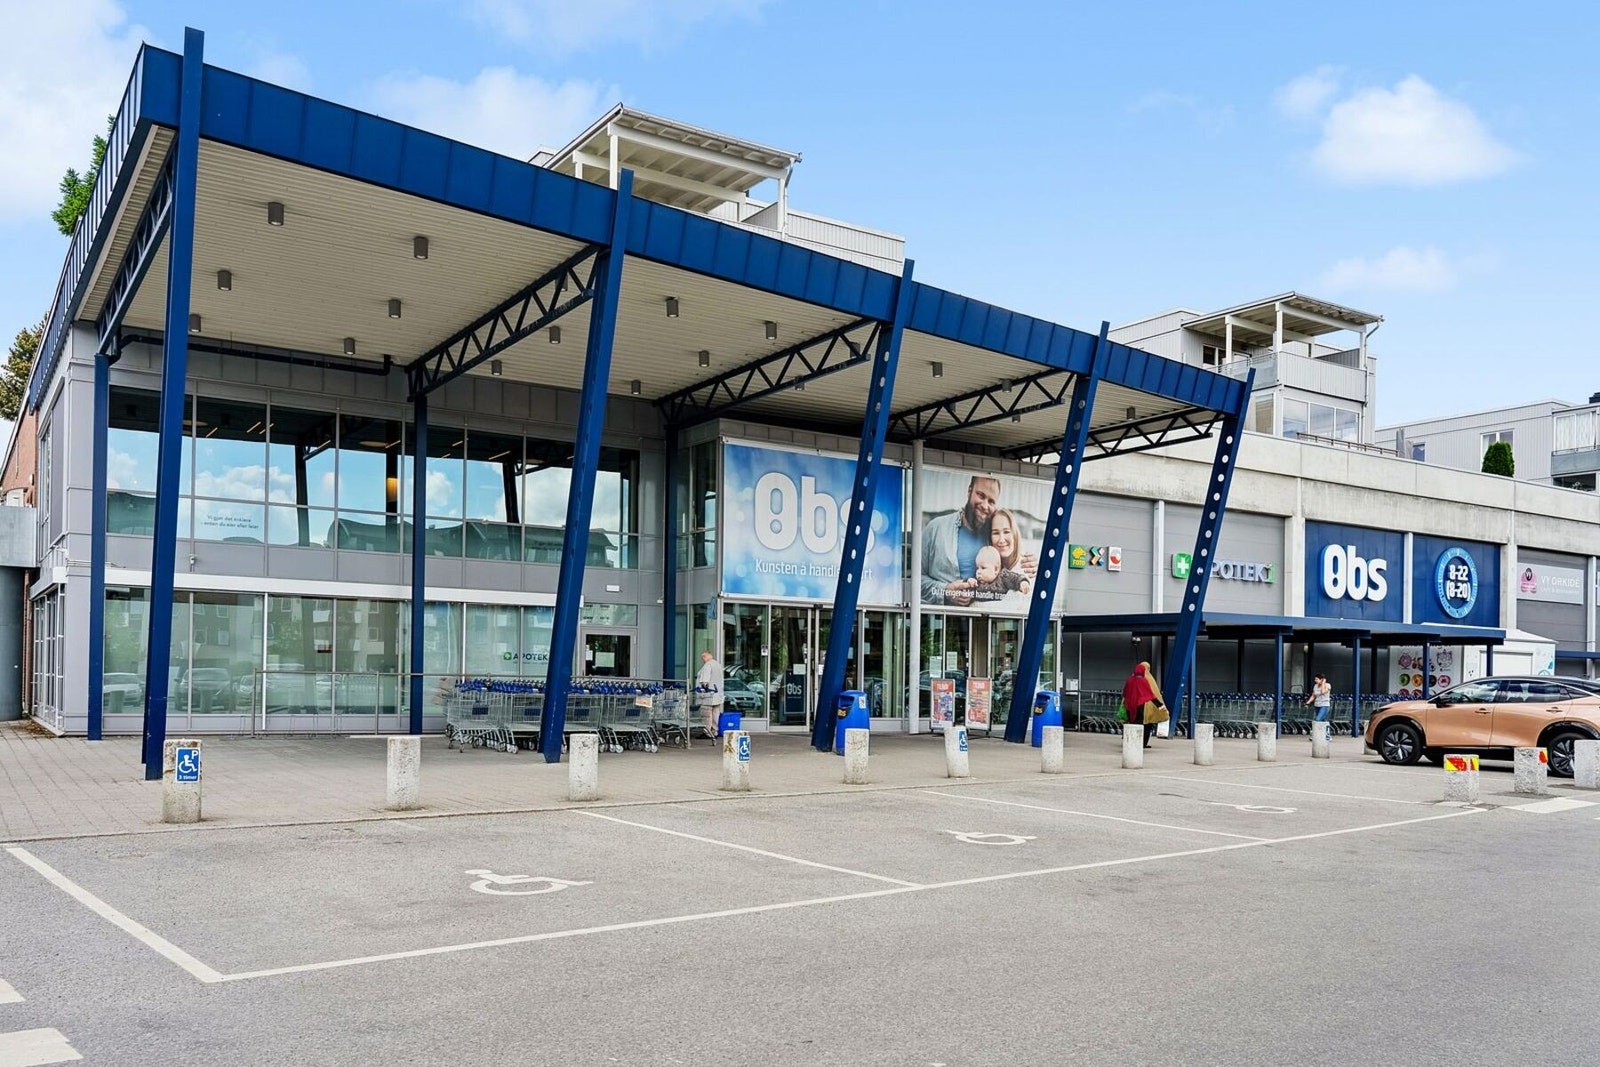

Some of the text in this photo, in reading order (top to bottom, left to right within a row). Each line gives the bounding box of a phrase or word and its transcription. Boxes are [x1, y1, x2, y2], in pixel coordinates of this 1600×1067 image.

[755, 559, 798, 575] Kunsten
[1323, 544, 1388, 602] Obs
[1449, 564, 1469, 581] 8-22
[1446, 580, 1471, 602] (8-20)
[787, 683, 802, 695] Obs
[191, 750, 199, 759] P
